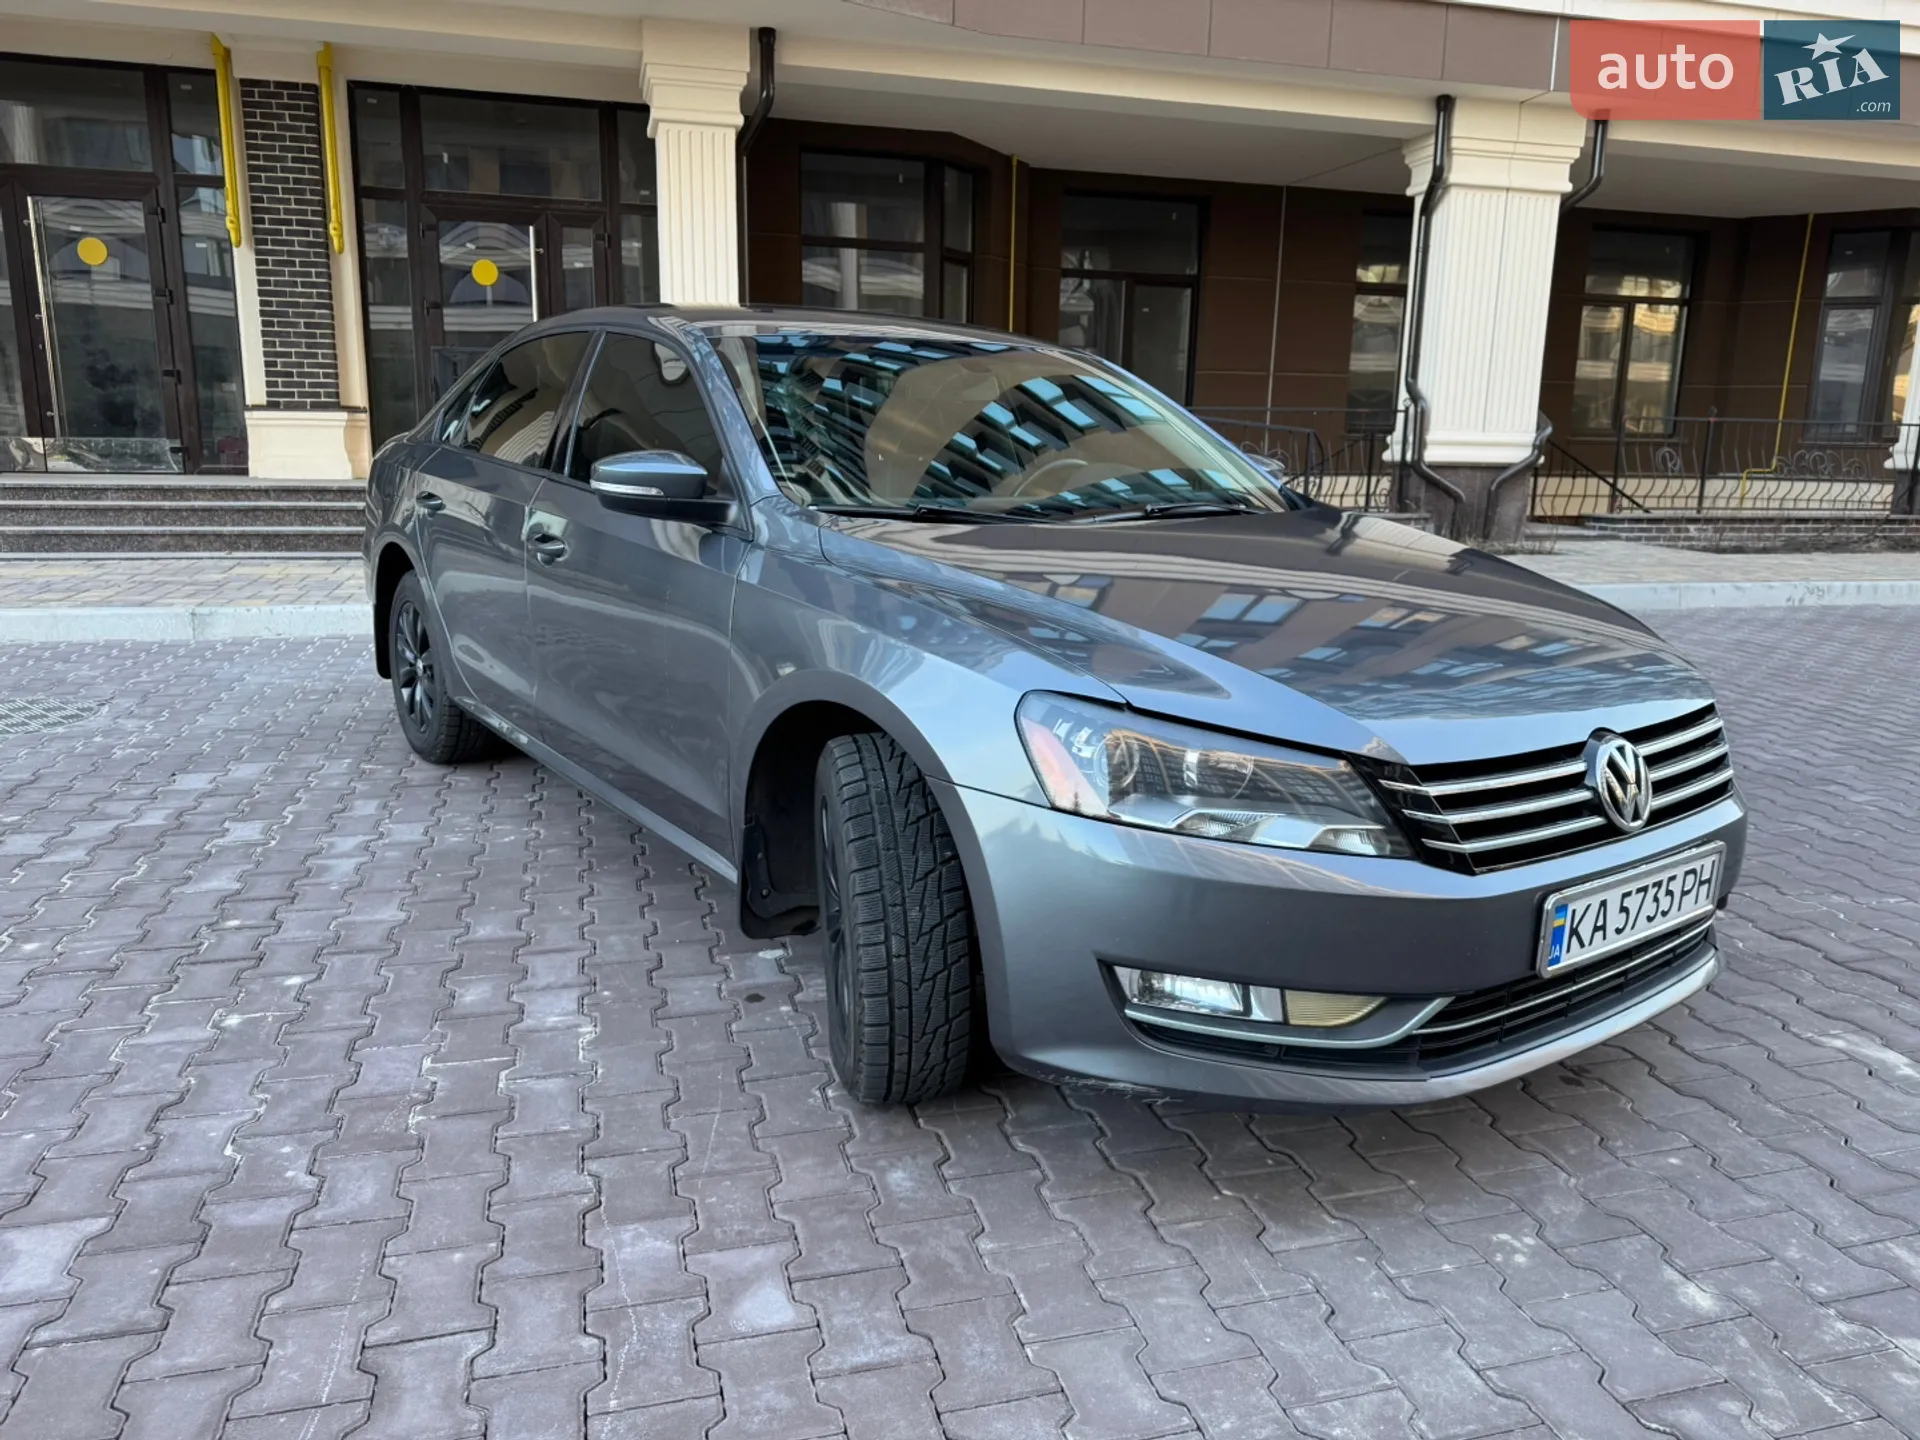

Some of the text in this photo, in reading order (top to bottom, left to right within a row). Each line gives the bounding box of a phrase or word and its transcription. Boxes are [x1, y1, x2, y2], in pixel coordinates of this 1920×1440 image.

[1566, 859, 1716, 953] KA 5735 PH
